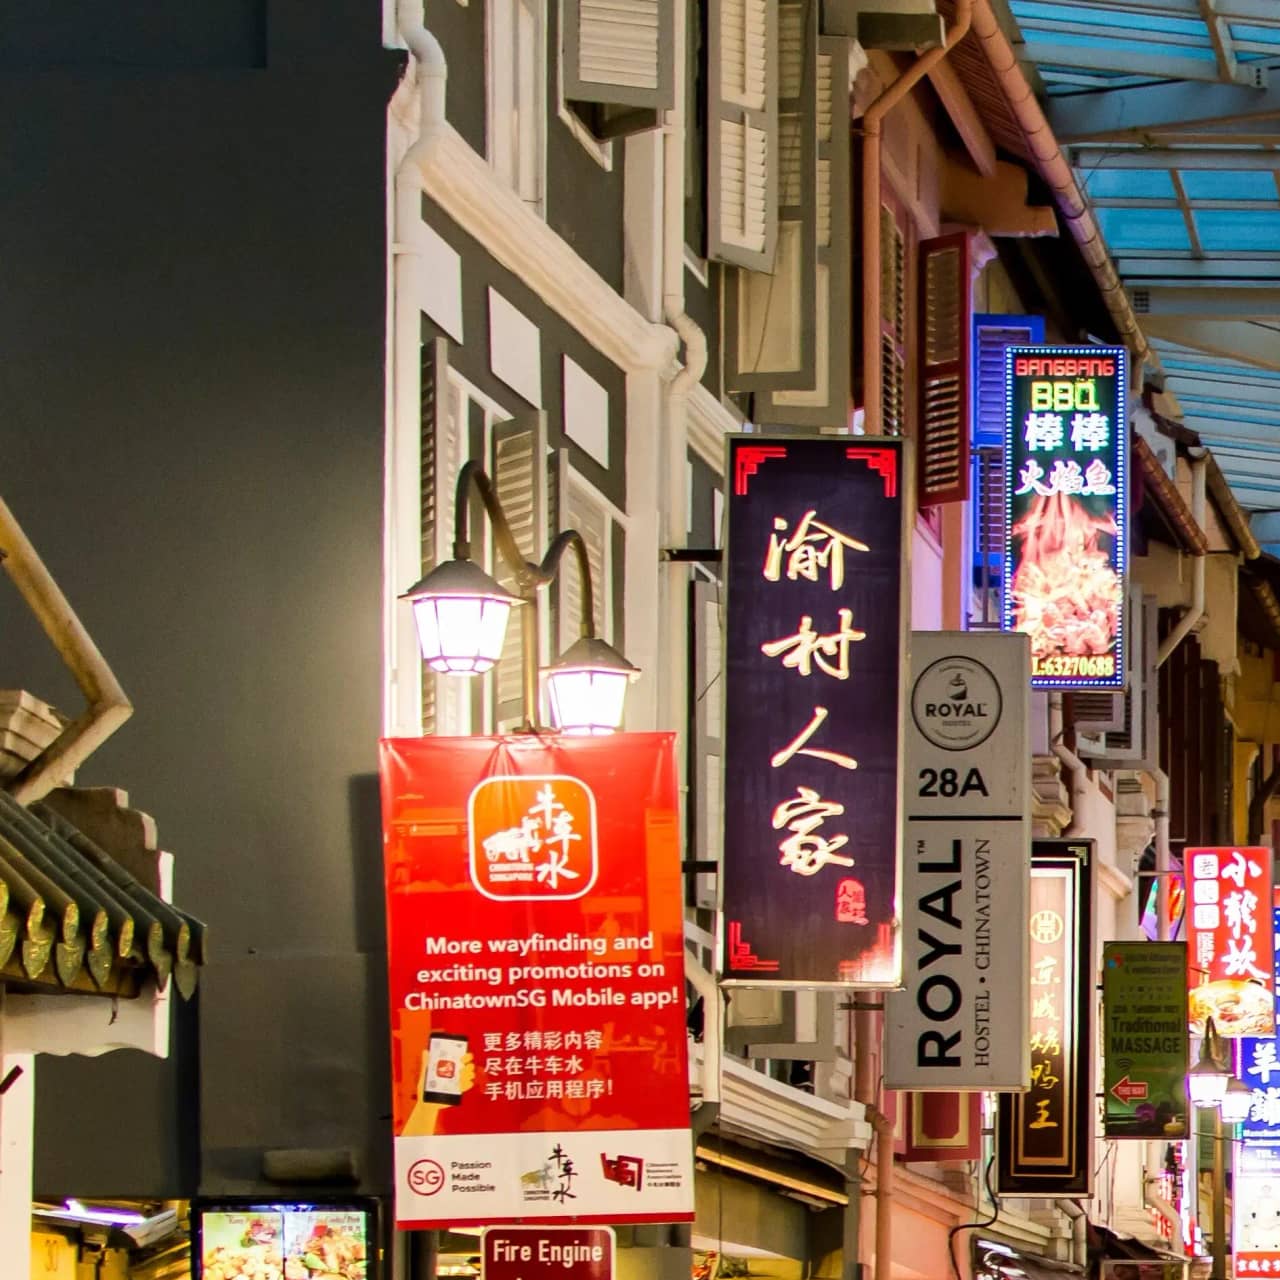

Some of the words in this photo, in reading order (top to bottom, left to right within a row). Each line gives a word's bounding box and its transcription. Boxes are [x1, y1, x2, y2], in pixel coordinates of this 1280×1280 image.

[1015, 358, 1115, 377] BANGBANG
[1031, 380, 1100, 412] BBQ
[926, 703, 987, 717] ROYAL
[918, 767, 989, 797] 28A
[975, 839, 990, 970] CHINATOWN
[425, 936, 483, 954] More
[488, 932, 607, 957] wayfinding
[613, 932, 654, 950] and
[917, 839, 962, 1067] ROYAL
[416, 964, 503, 985] exciting
[508, 962, 631, 984] promotions
[637, 965, 665, 977] on
[404, 989, 547, 1011] ChinatownSG
[552, 988, 625, 1006] Mobile
[631, 987, 679, 1010] app!
[975, 991, 990, 1067] HOSTEL
[1111, 1016, 1181, 1033] Traditional
[483, 1030, 603, 1052] 更多精彩内容
[1111, 1037, 1181, 1054] MASSAGE
[483, 1054, 584, 1077] 尽在牛车水
[451, 1161, 492, 1170] Passion
[451, 1172, 481, 1182] Made
[412, 1170, 440, 1186] SG
[451, 1183, 496, 1193] Possible
[493, 1240, 530, 1262] Fire
[538, 1240, 604, 1268] Engine
